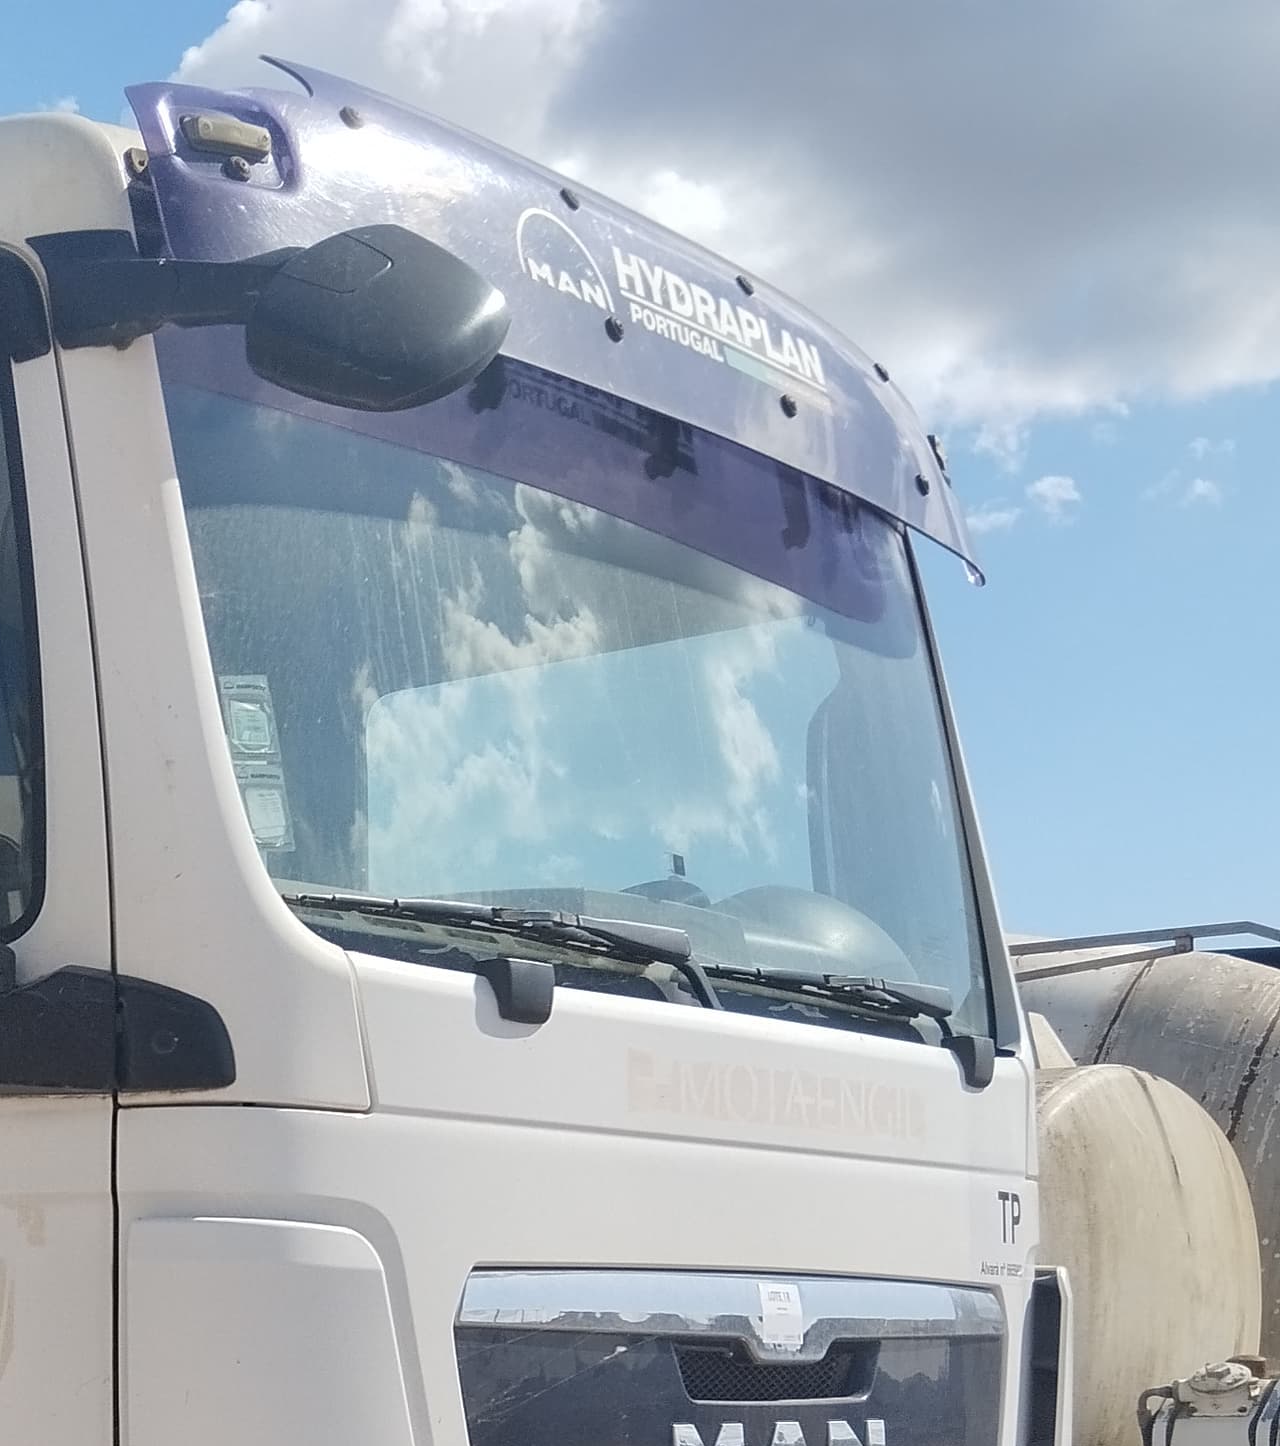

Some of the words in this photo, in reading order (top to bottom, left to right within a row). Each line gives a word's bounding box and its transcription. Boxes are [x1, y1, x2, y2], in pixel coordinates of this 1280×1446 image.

[529, 258, 609, 309] MAN
[612, 246, 826, 384] HYDRAPLAN
[629, 301, 725, 363] PORTUGAL
[997, 1190, 1021, 1244] TP
